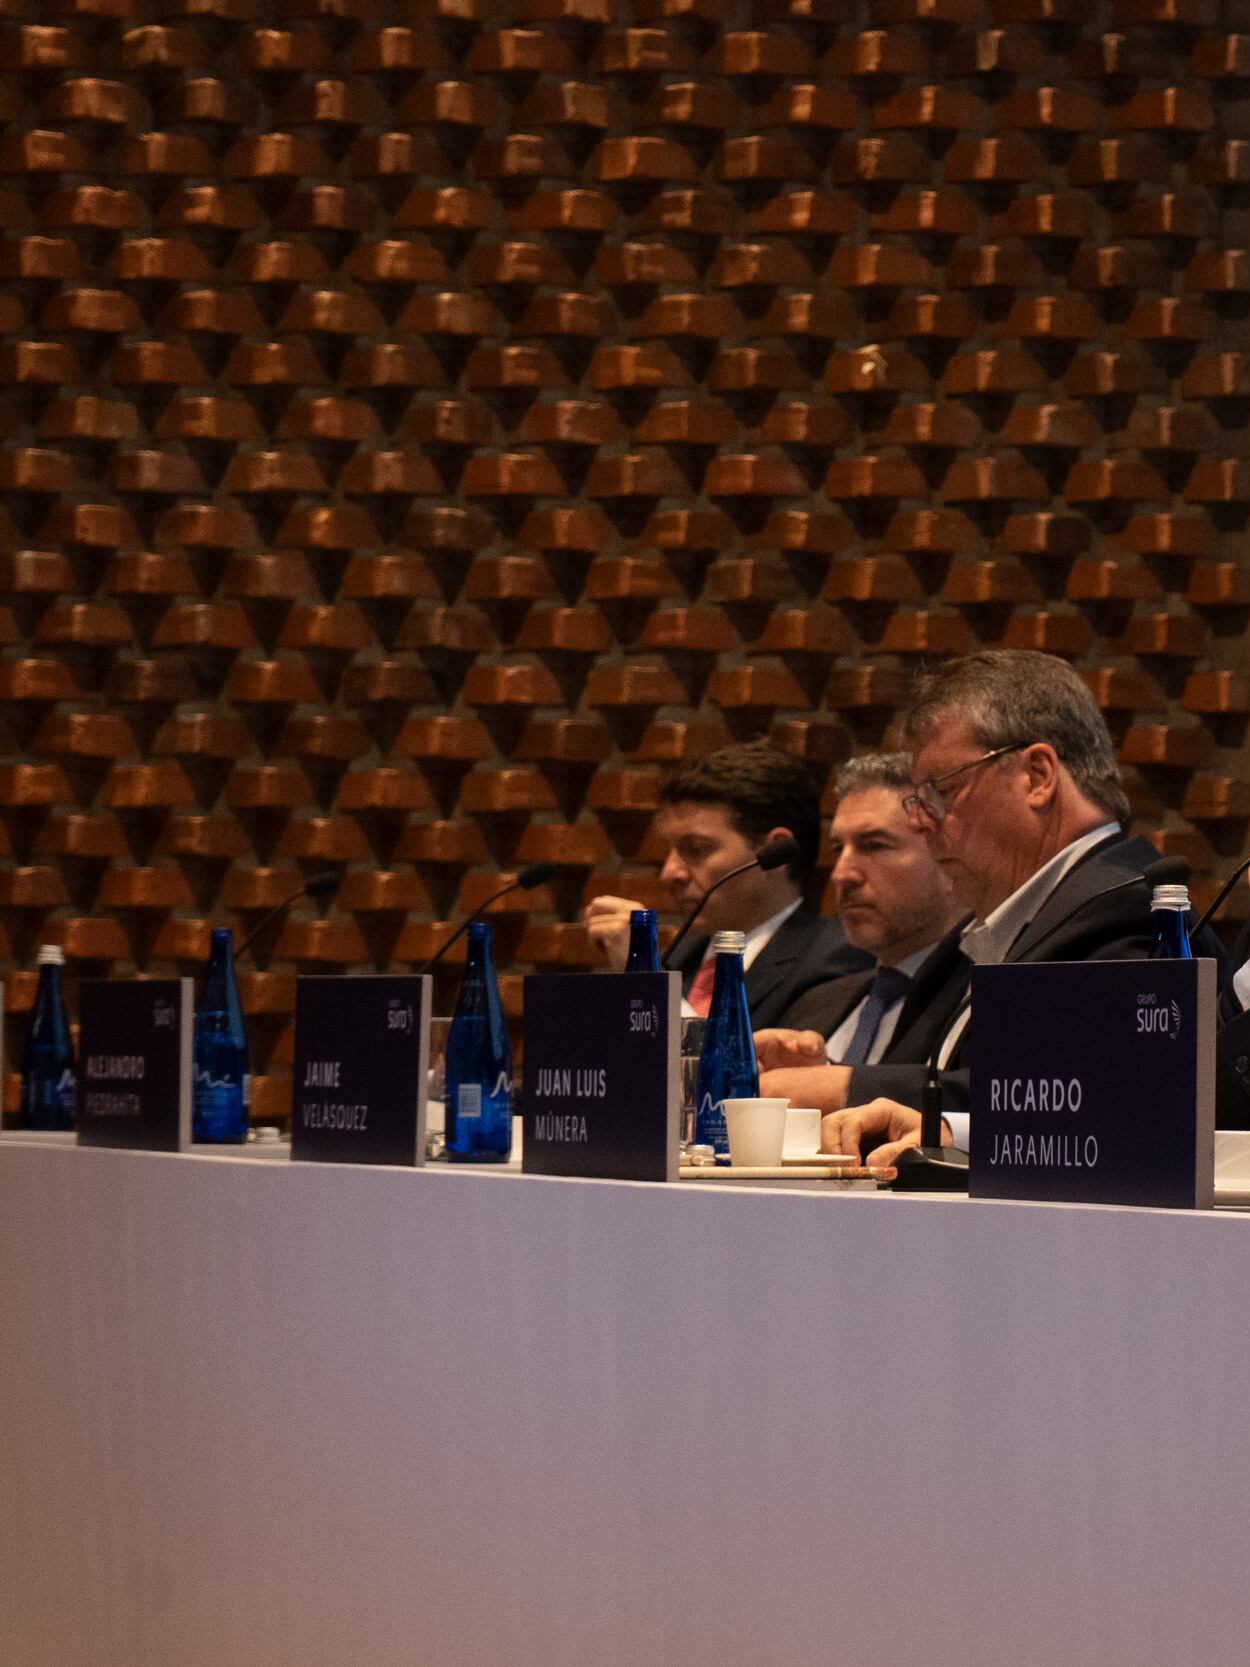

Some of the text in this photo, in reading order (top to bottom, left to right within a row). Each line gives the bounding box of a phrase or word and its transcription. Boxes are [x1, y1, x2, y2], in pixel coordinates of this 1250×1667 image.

[1137, 993, 1157, 1005] GRUPO
[630, 1010, 652, 1032] sura
[1136, 1007, 1169, 1032] sura
[303, 1062, 341, 1088] JAIME
[535, 1068, 607, 1098] JUAN LUIS
[991, 1077, 1082, 1112] RICARDO
[535, 1110, 588, 1143] MÚNERA
[989, 1133, 1099, 1168] JARAMILLO
